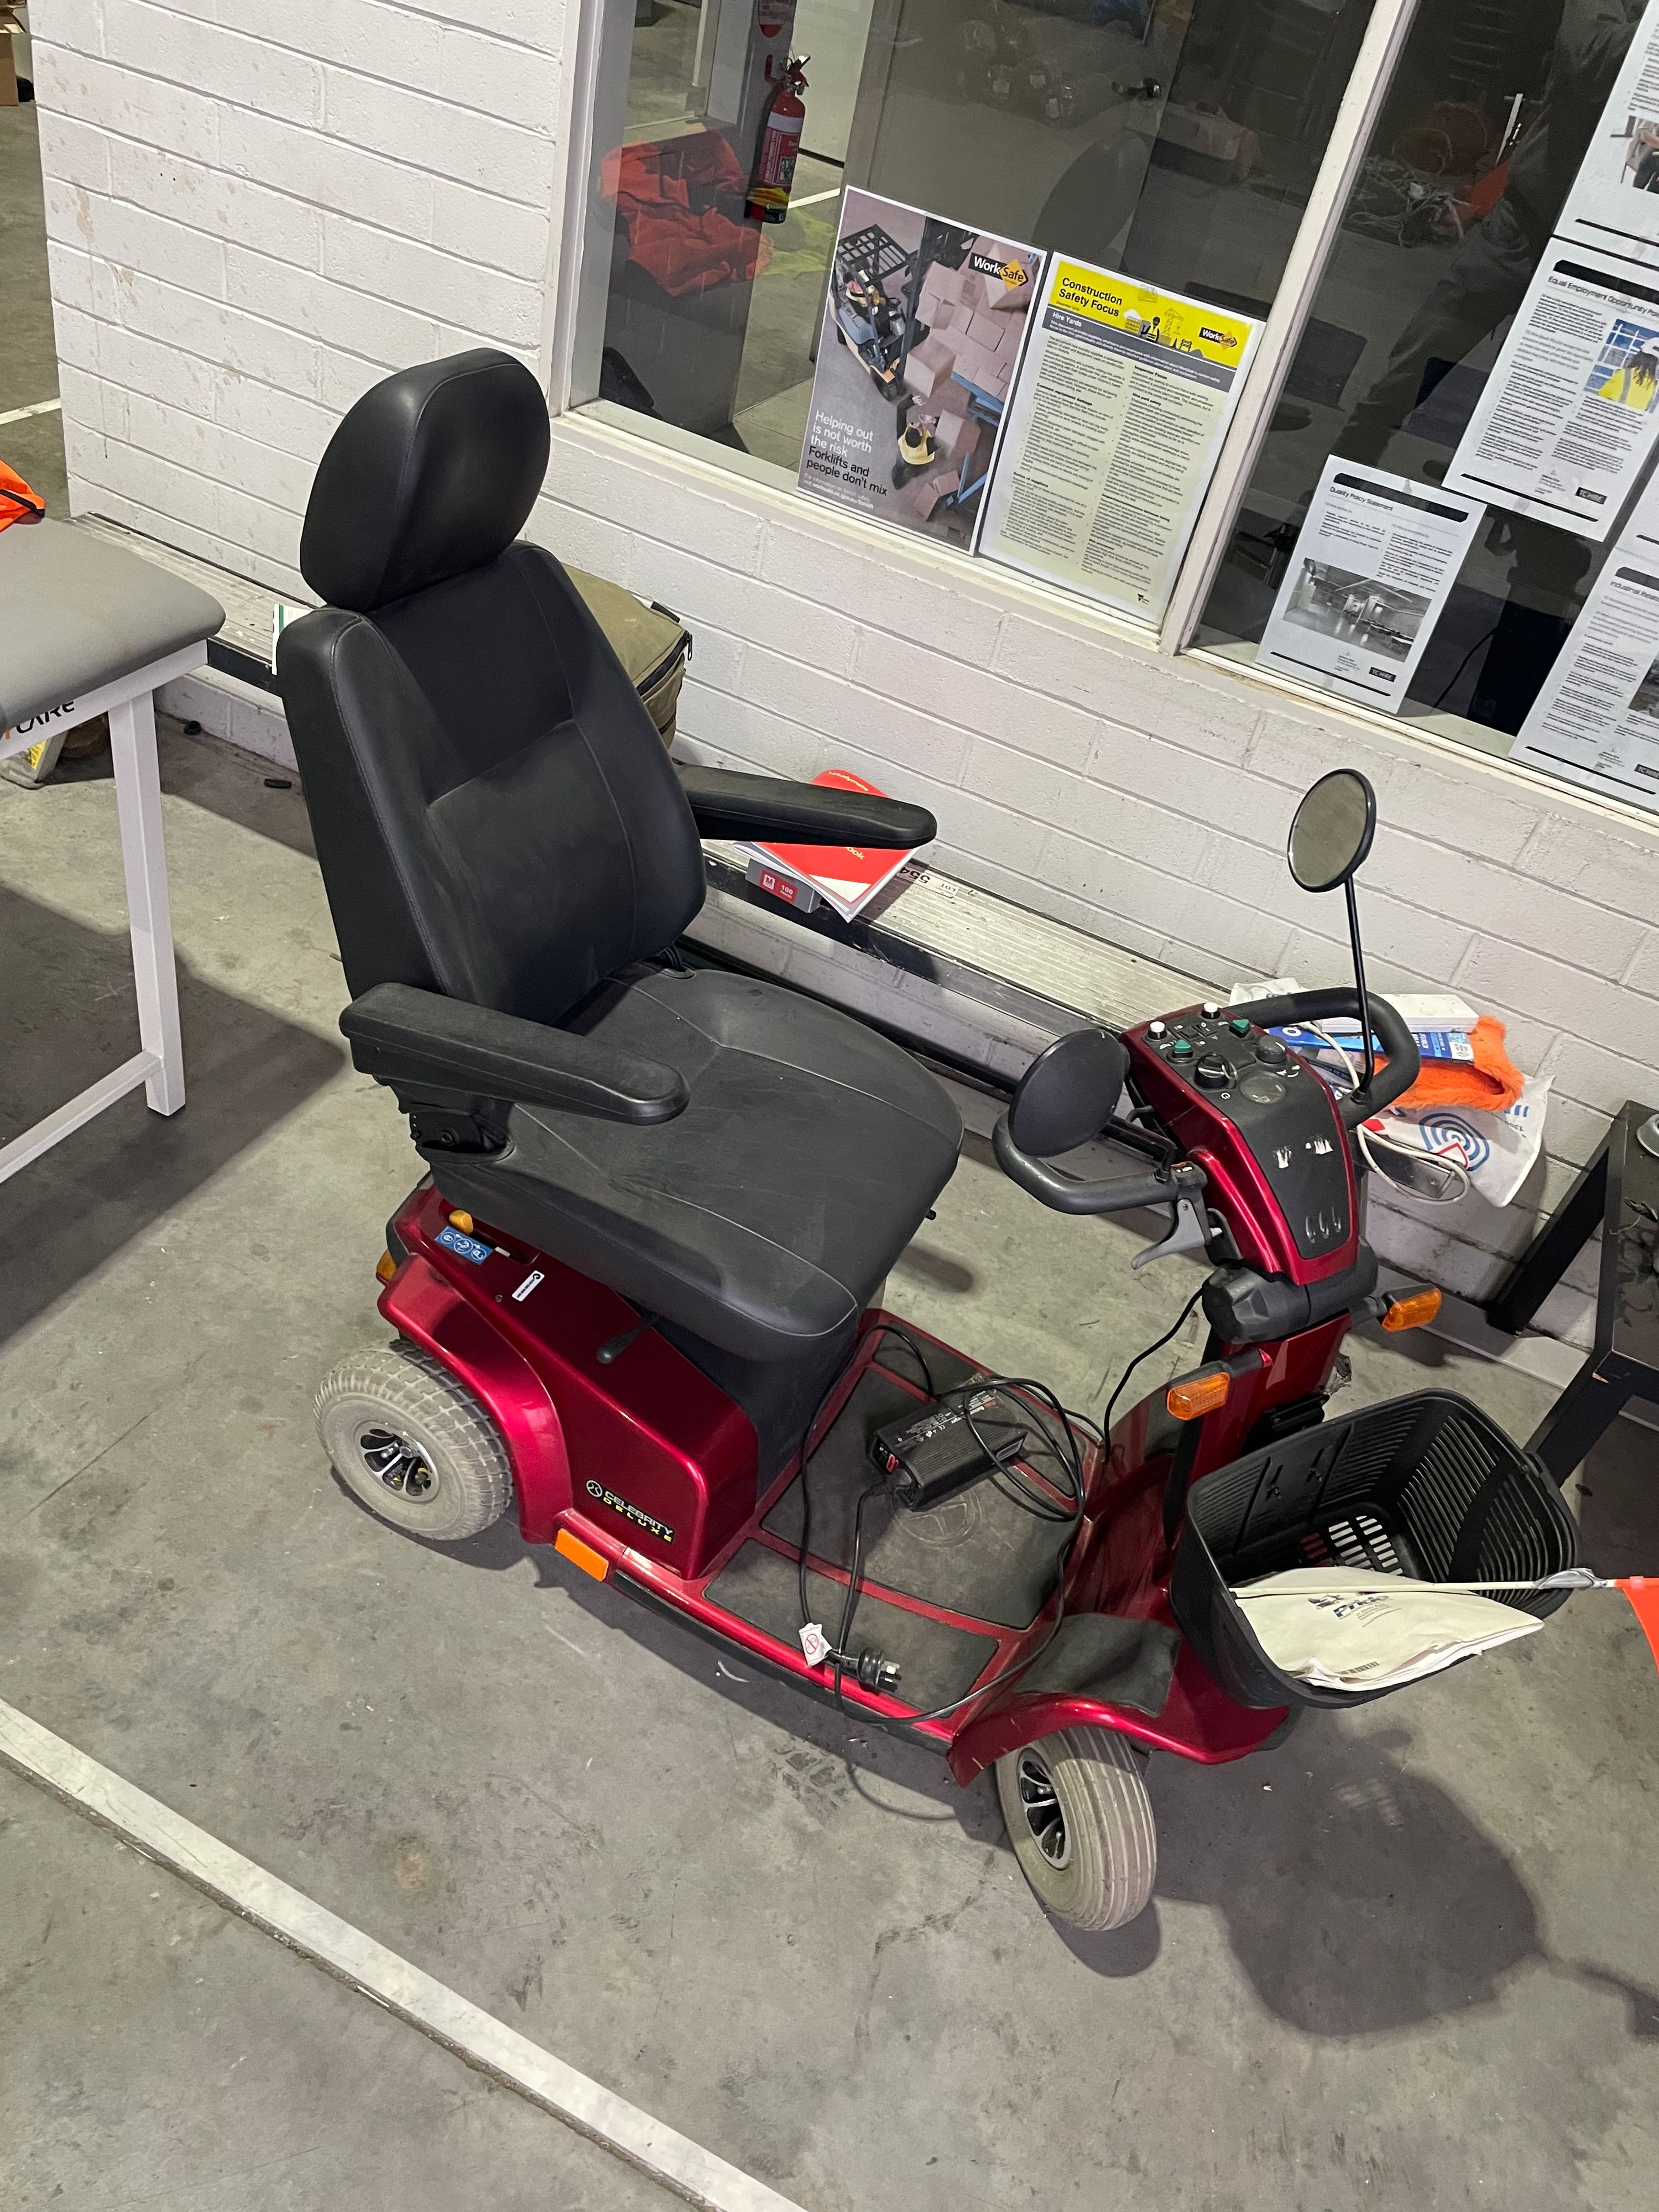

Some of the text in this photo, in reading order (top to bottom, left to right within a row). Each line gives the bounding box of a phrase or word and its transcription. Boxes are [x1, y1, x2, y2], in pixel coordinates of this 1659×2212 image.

[1059, 289, 1119, 316] Safety Focus
[1062, 278, 1122, 305] Construction
[1548, 276, 1567, 287] Equal
[1568, 283, 1608, 300] Employment
[1608, 295, 1647, 314] Opportunity
[1052, 312, 1082, 327] Hire Yards
[812, 422, 872, 453] is not worth
[815, 410, 874, 441] Helping out
[811, 434, 848, 457] the risk
[808, 445, 870, 477] Forklifts and
[806, 460, 888, 496] people don't mix
[1330, 487, 1394, 512] Quality Policy Statement
[846, 847, 865, 860] ook
[781, 884, 794, 895] 100
[900, 867, 957, 893] LOT 554
[603, 1496, 672, 1542] DELUXE
[604, 1490, 674, 1535] CELEBRITY
